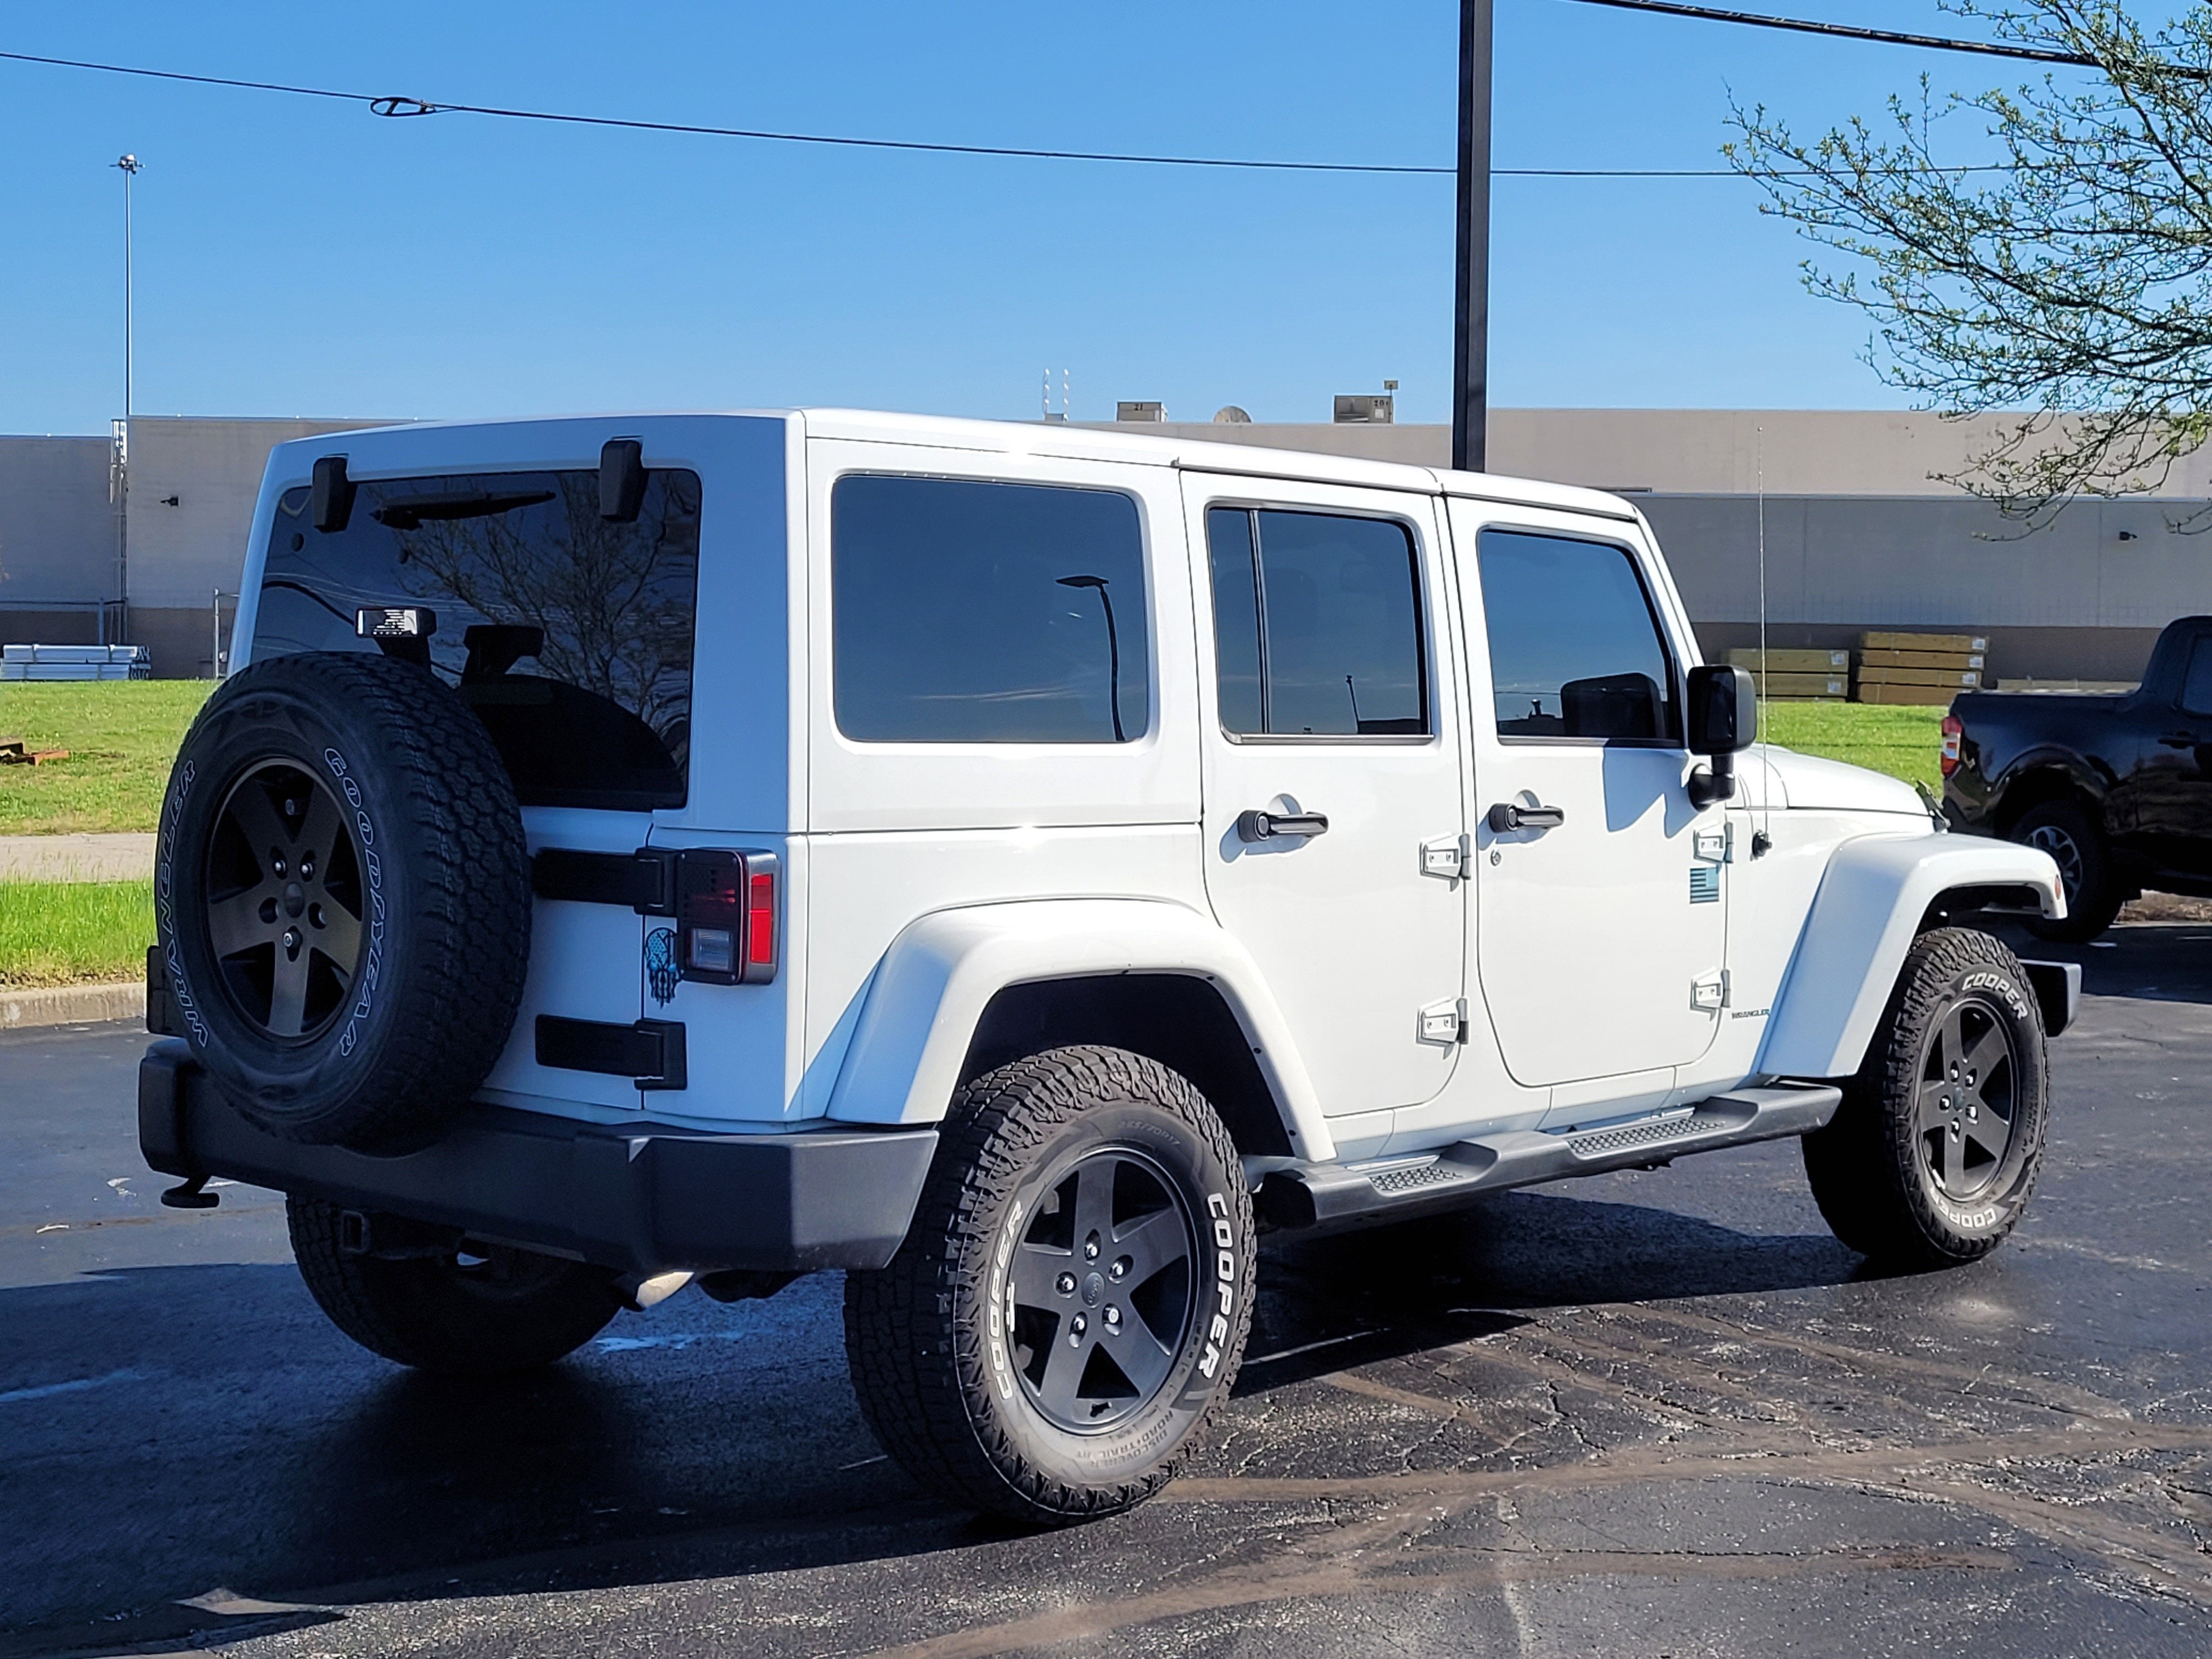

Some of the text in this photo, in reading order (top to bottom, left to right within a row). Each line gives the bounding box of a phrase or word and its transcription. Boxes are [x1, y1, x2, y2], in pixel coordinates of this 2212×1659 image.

[160, 759, 207, 1048] WRANGLER
[324, 748, 385, 1057] GOODYEAR
[1962, 972, 2028, 1020] COOPER
[989, 1200, 1023, 1400] COOPER
[1198, 1192, 1233, 1379] COOPER
[1929, 1186, 1997, 1228] COOPER
[1090, 1430, 1167, 1468] DISCOVERER
